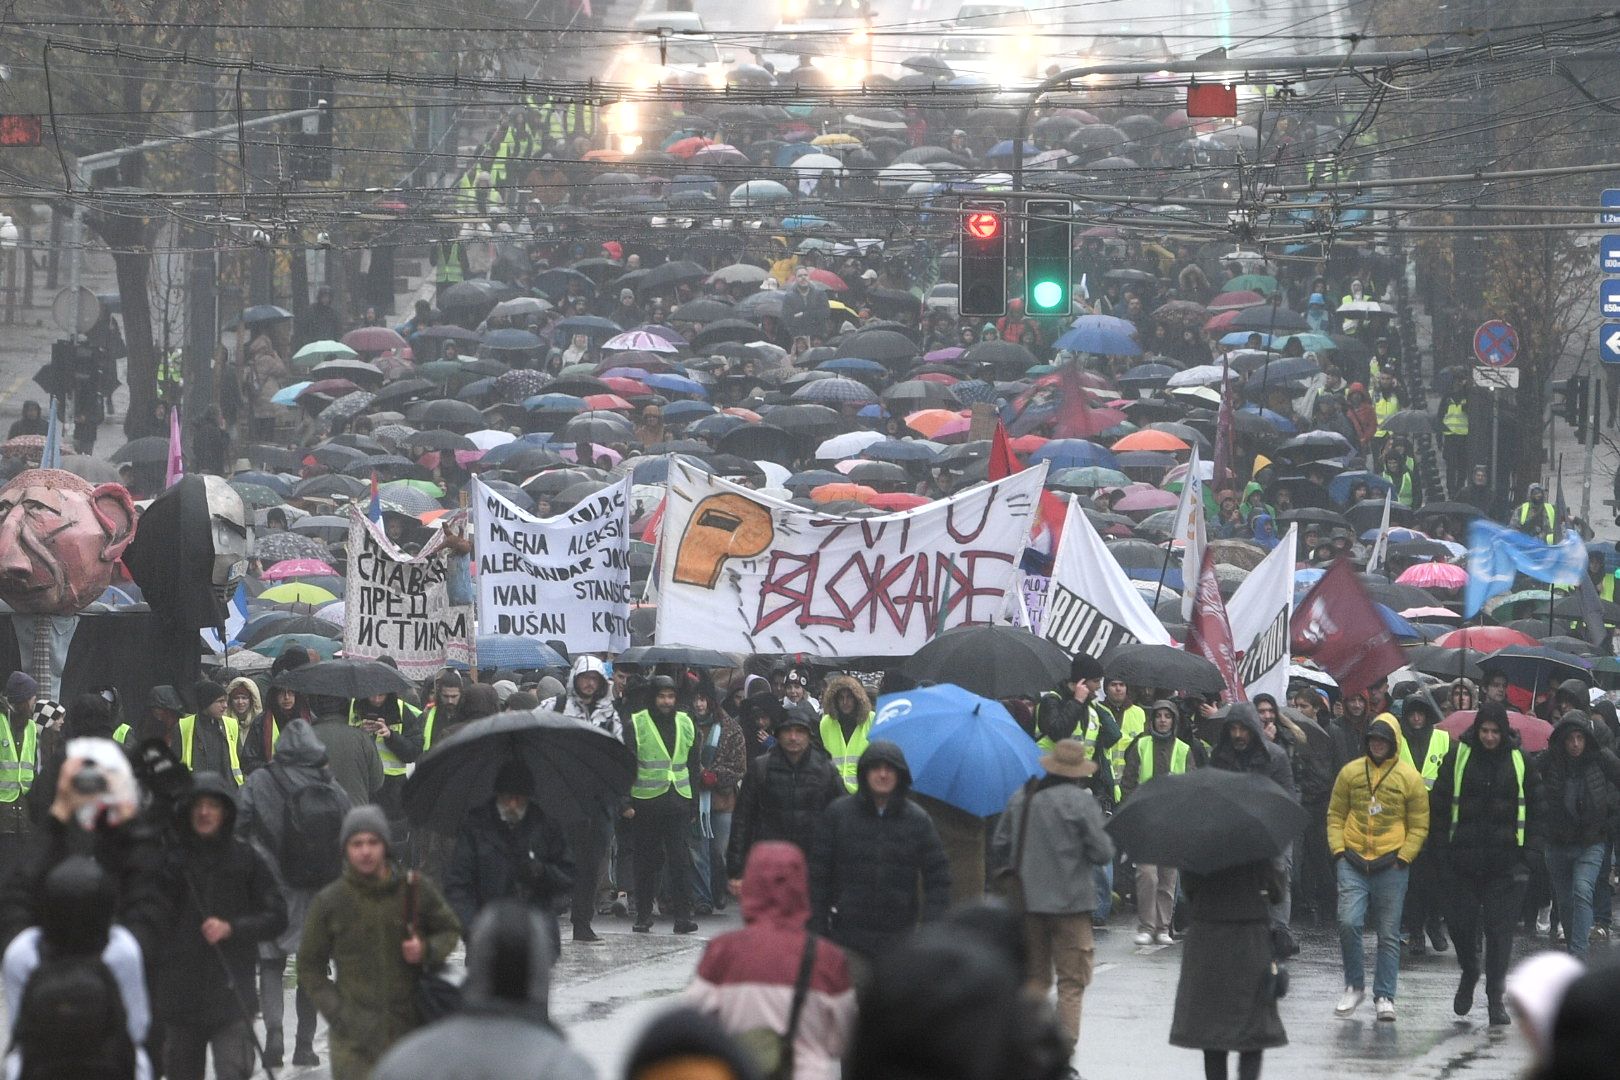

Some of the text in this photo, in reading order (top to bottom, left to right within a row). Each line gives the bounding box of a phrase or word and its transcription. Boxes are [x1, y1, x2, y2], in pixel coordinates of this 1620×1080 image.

[947, 484, 999, 545] U
[490, 523, 549, 555] MILENA
[480, 552, 594, 582] ALEKSANDAR
[360, 585, 428, 620] ПРЕД
[493, 584, 536, 606] IVAN
[752, 549, 1014, 641] BLOKADE
[358, 613, 467, 651] ИСТИНОМ
[1048, 585, 1113, 660] RULA
